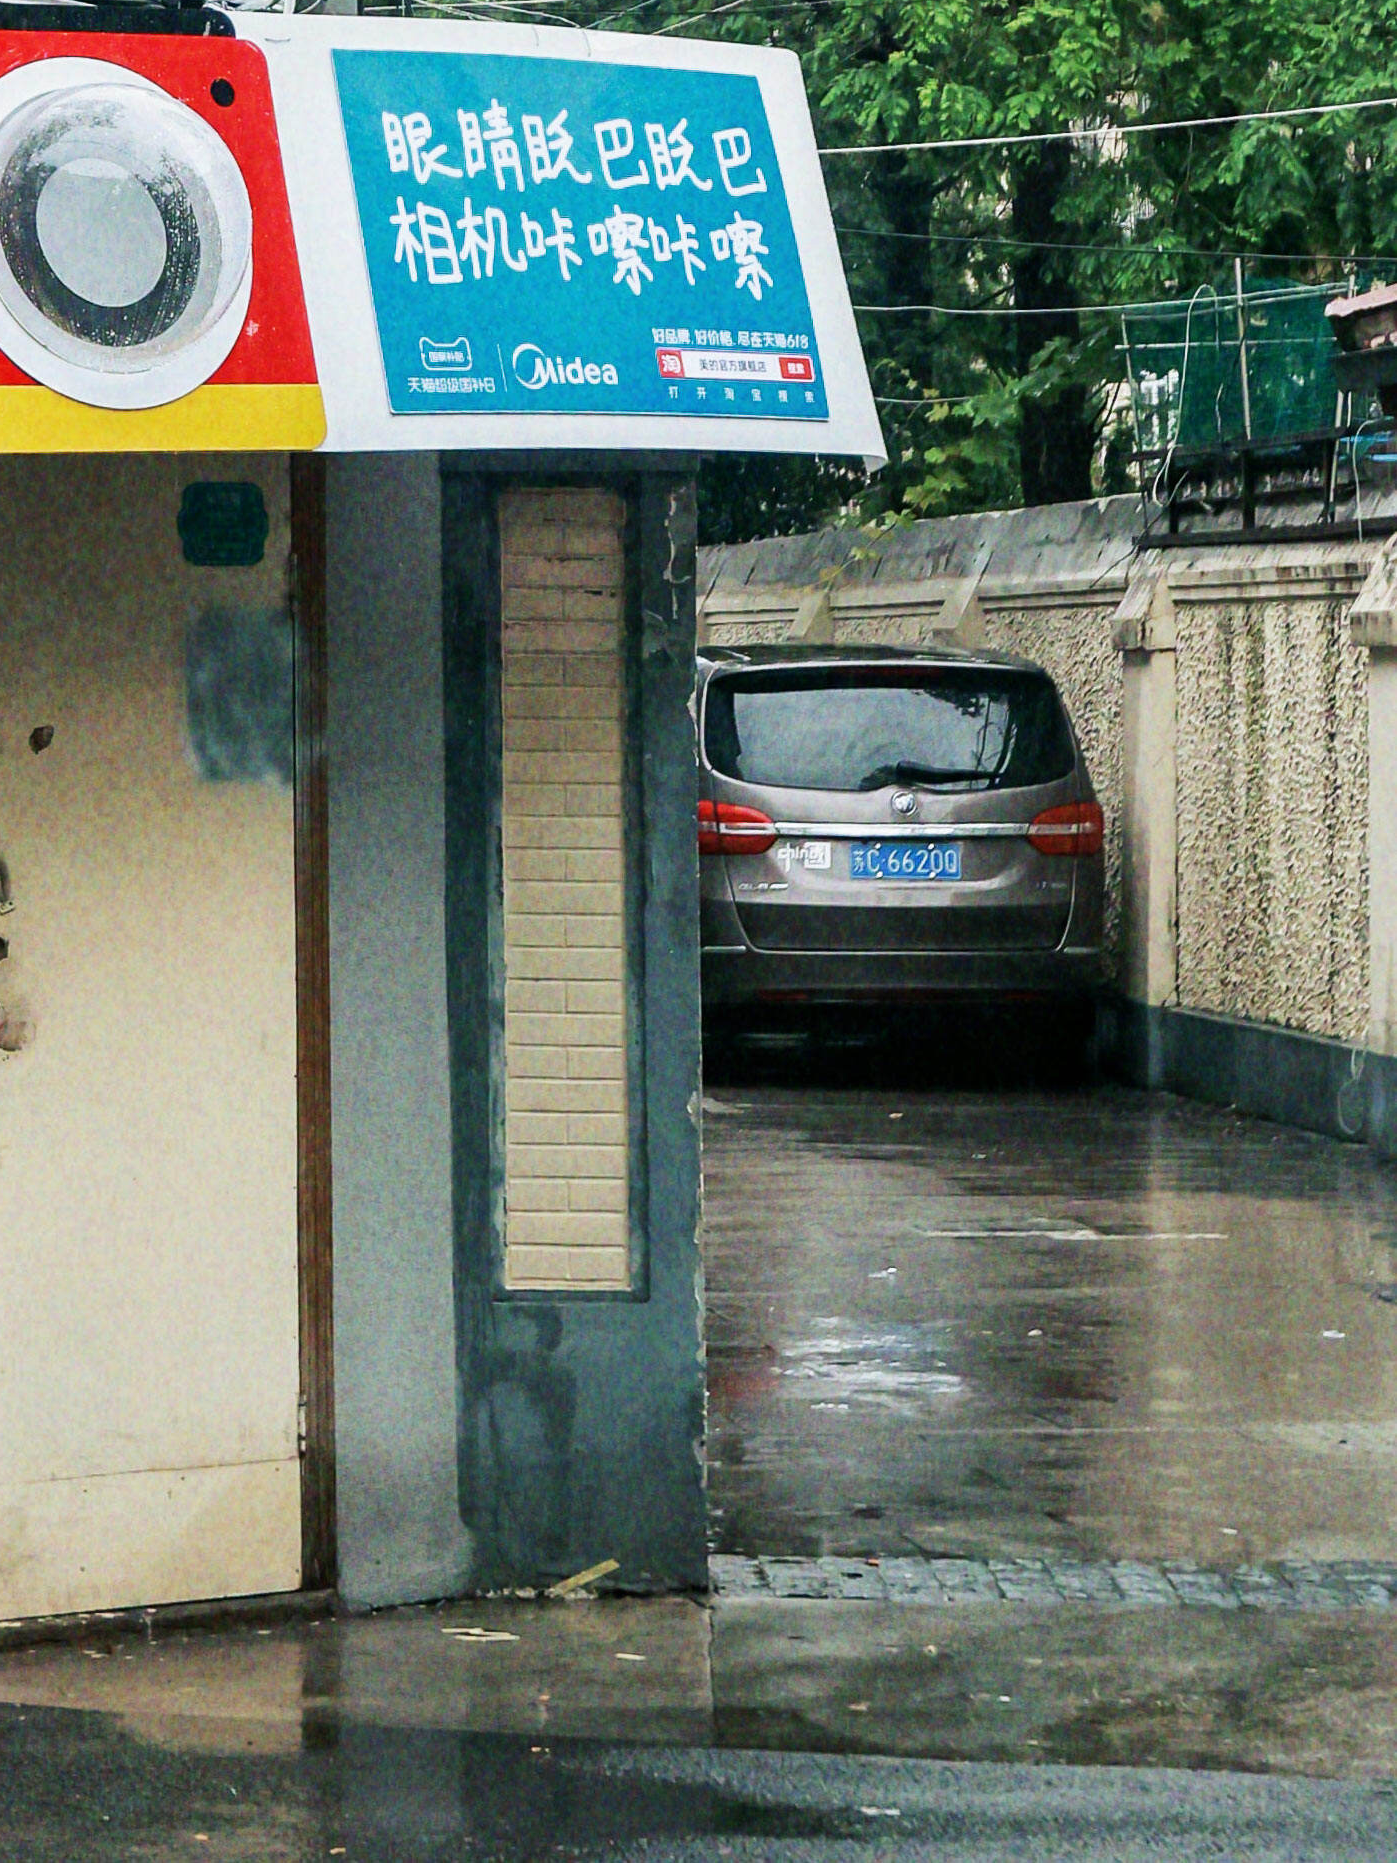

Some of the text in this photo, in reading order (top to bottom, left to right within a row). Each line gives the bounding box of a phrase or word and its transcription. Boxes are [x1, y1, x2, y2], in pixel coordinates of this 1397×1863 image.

[381, 98, 768, 197] 眼睛眨巴眨巴
[390, 196, 773, 301] 相机咔嚓咔嚓
[407, 377, 496, 393] 天猫超级国补日
[512, 343, 619, 390] Midea
